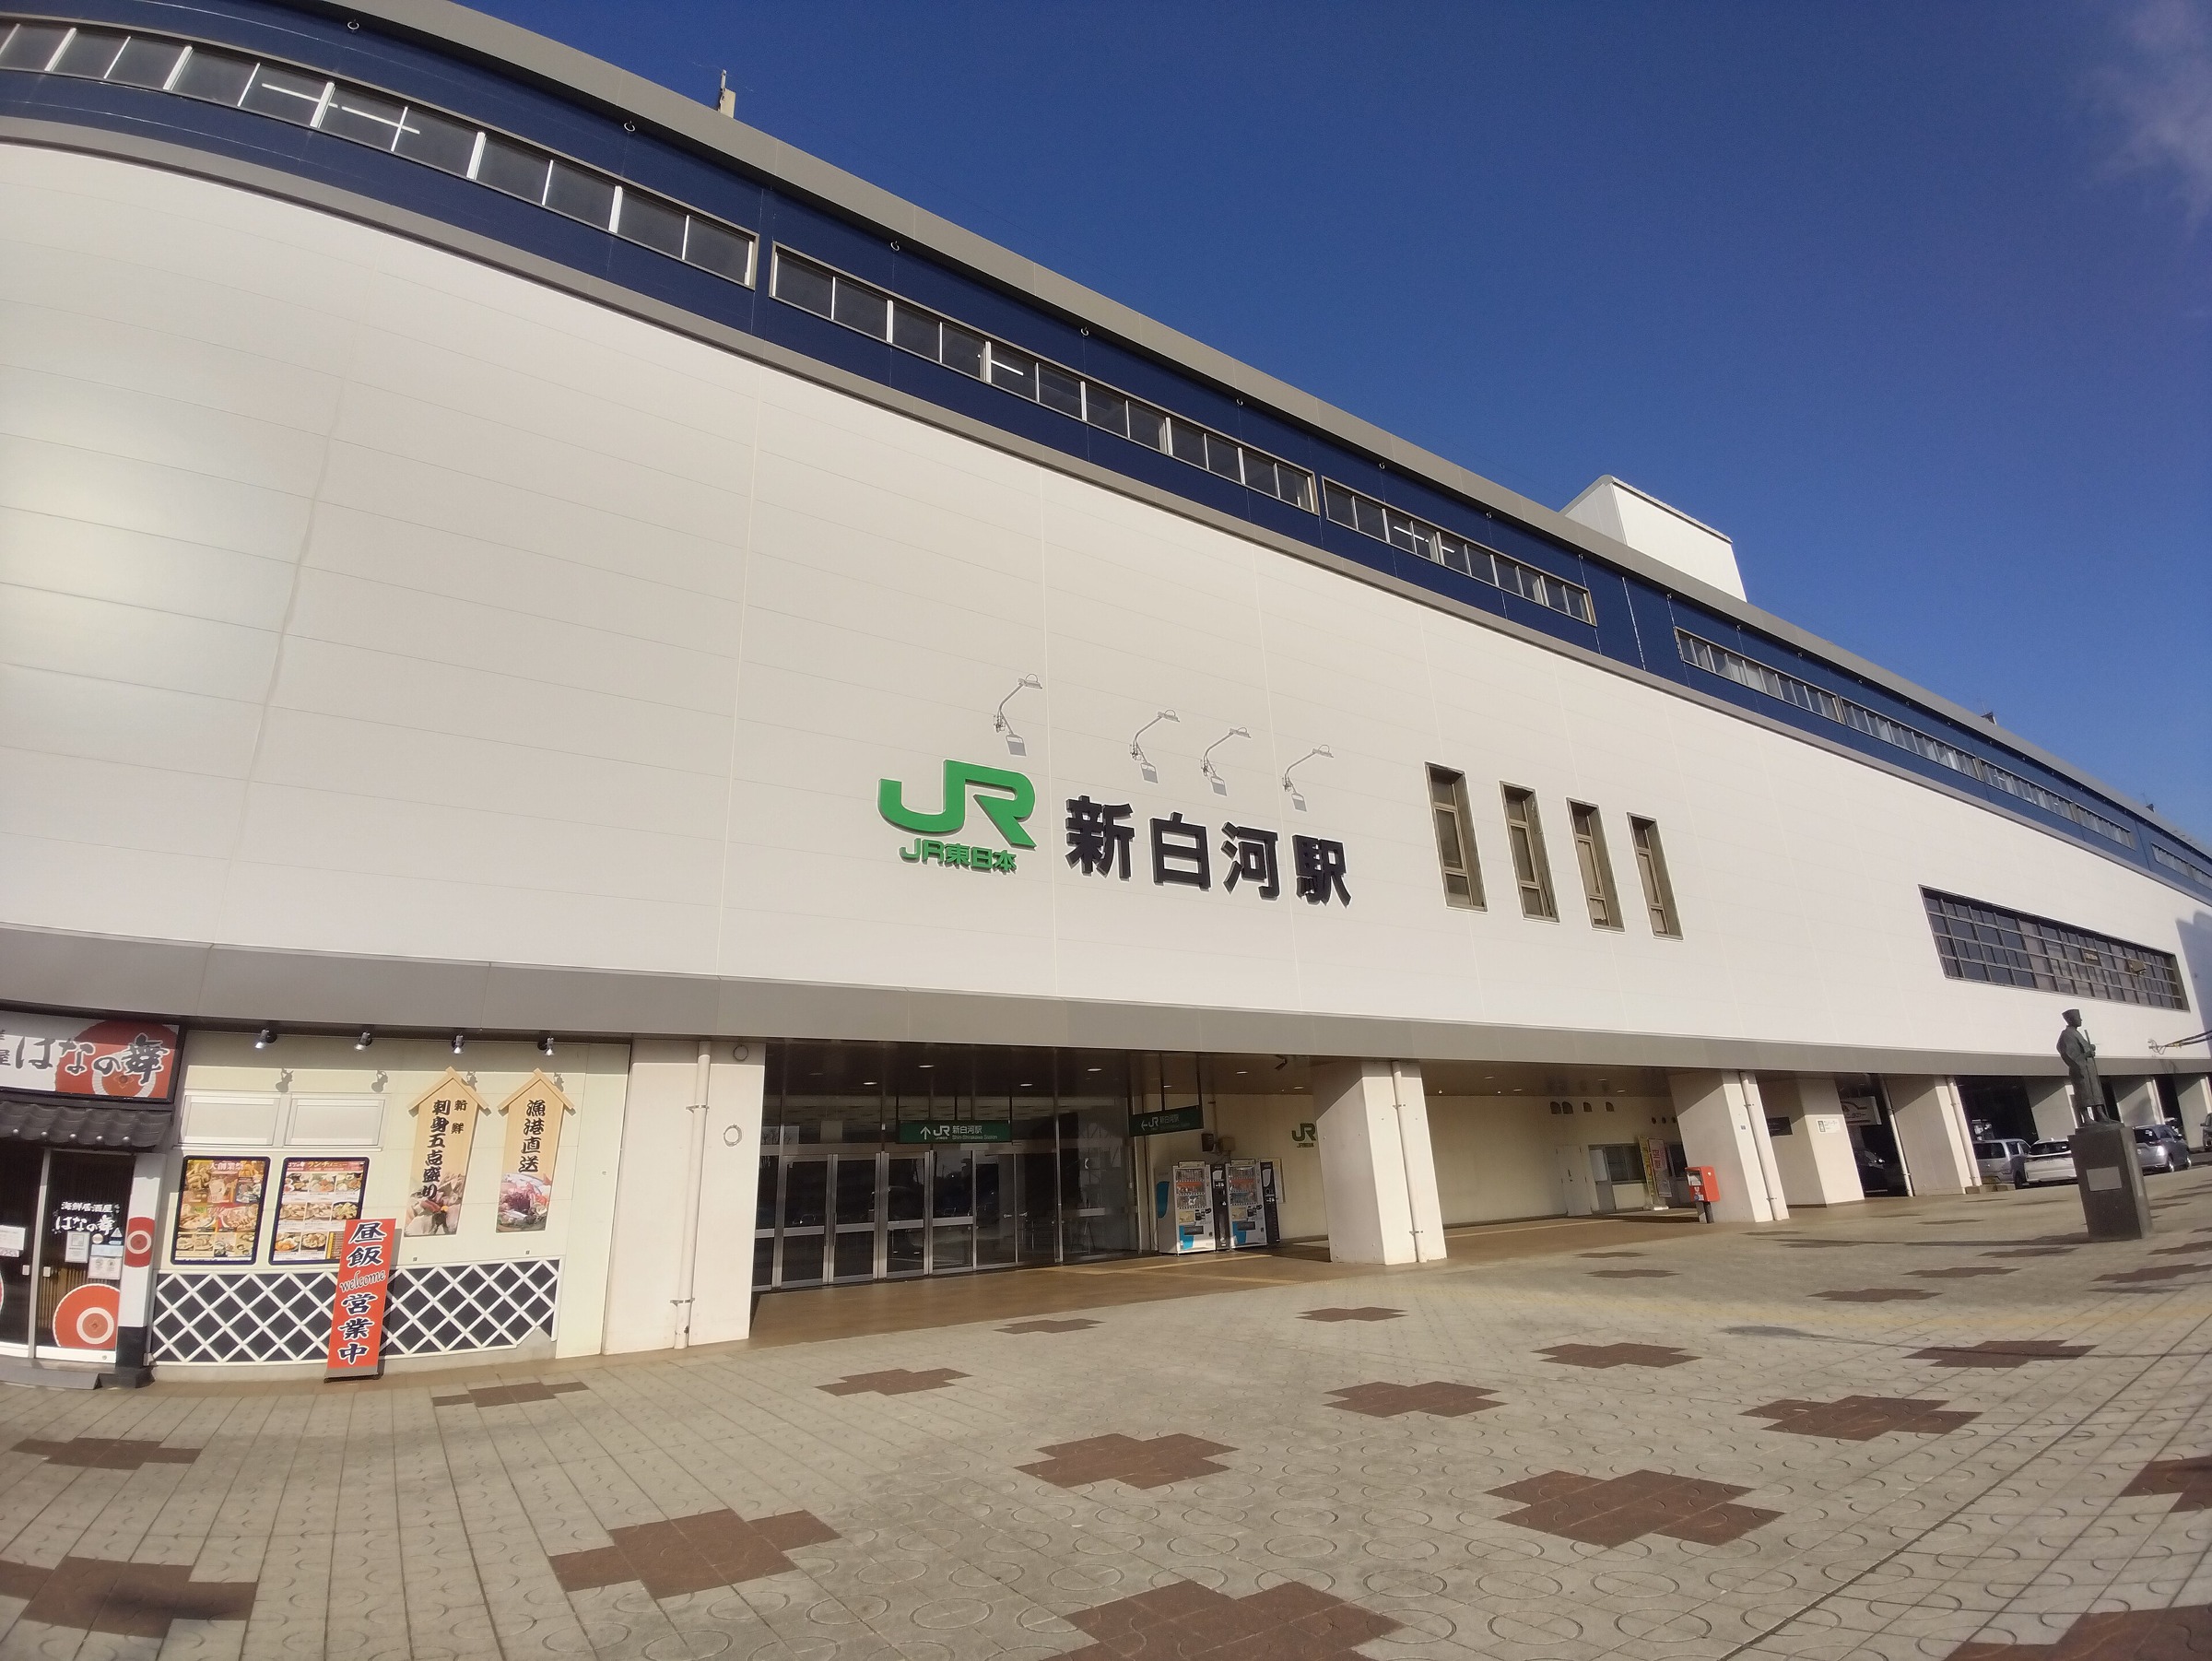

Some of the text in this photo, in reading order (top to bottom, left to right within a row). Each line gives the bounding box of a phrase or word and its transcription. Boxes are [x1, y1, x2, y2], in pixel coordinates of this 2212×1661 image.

[878, 760, 1037, 851] JR
[899, 837, 1017, 873] JR東日本
[1065, 795, 1352, 909] 新白河駅
[15, 1032, 170, 1086] はなの舞
[450, 1099, 468, 1135] 新鮮
[517, 1099, 547, 1173] 漁港直送
[933, 1125, 950, 1136] JR
[1291, 1123, 1317, 1142] JR
[421, 1099, 451, 1200] 刺身五点盛り
[55, 1214, 116, 1235] はなの舞
[347, 1221, 387, 1268] 昼飯
[339, 1269, 386, 1292] welcome
[337, 1292, 378, 1364] 営業中
